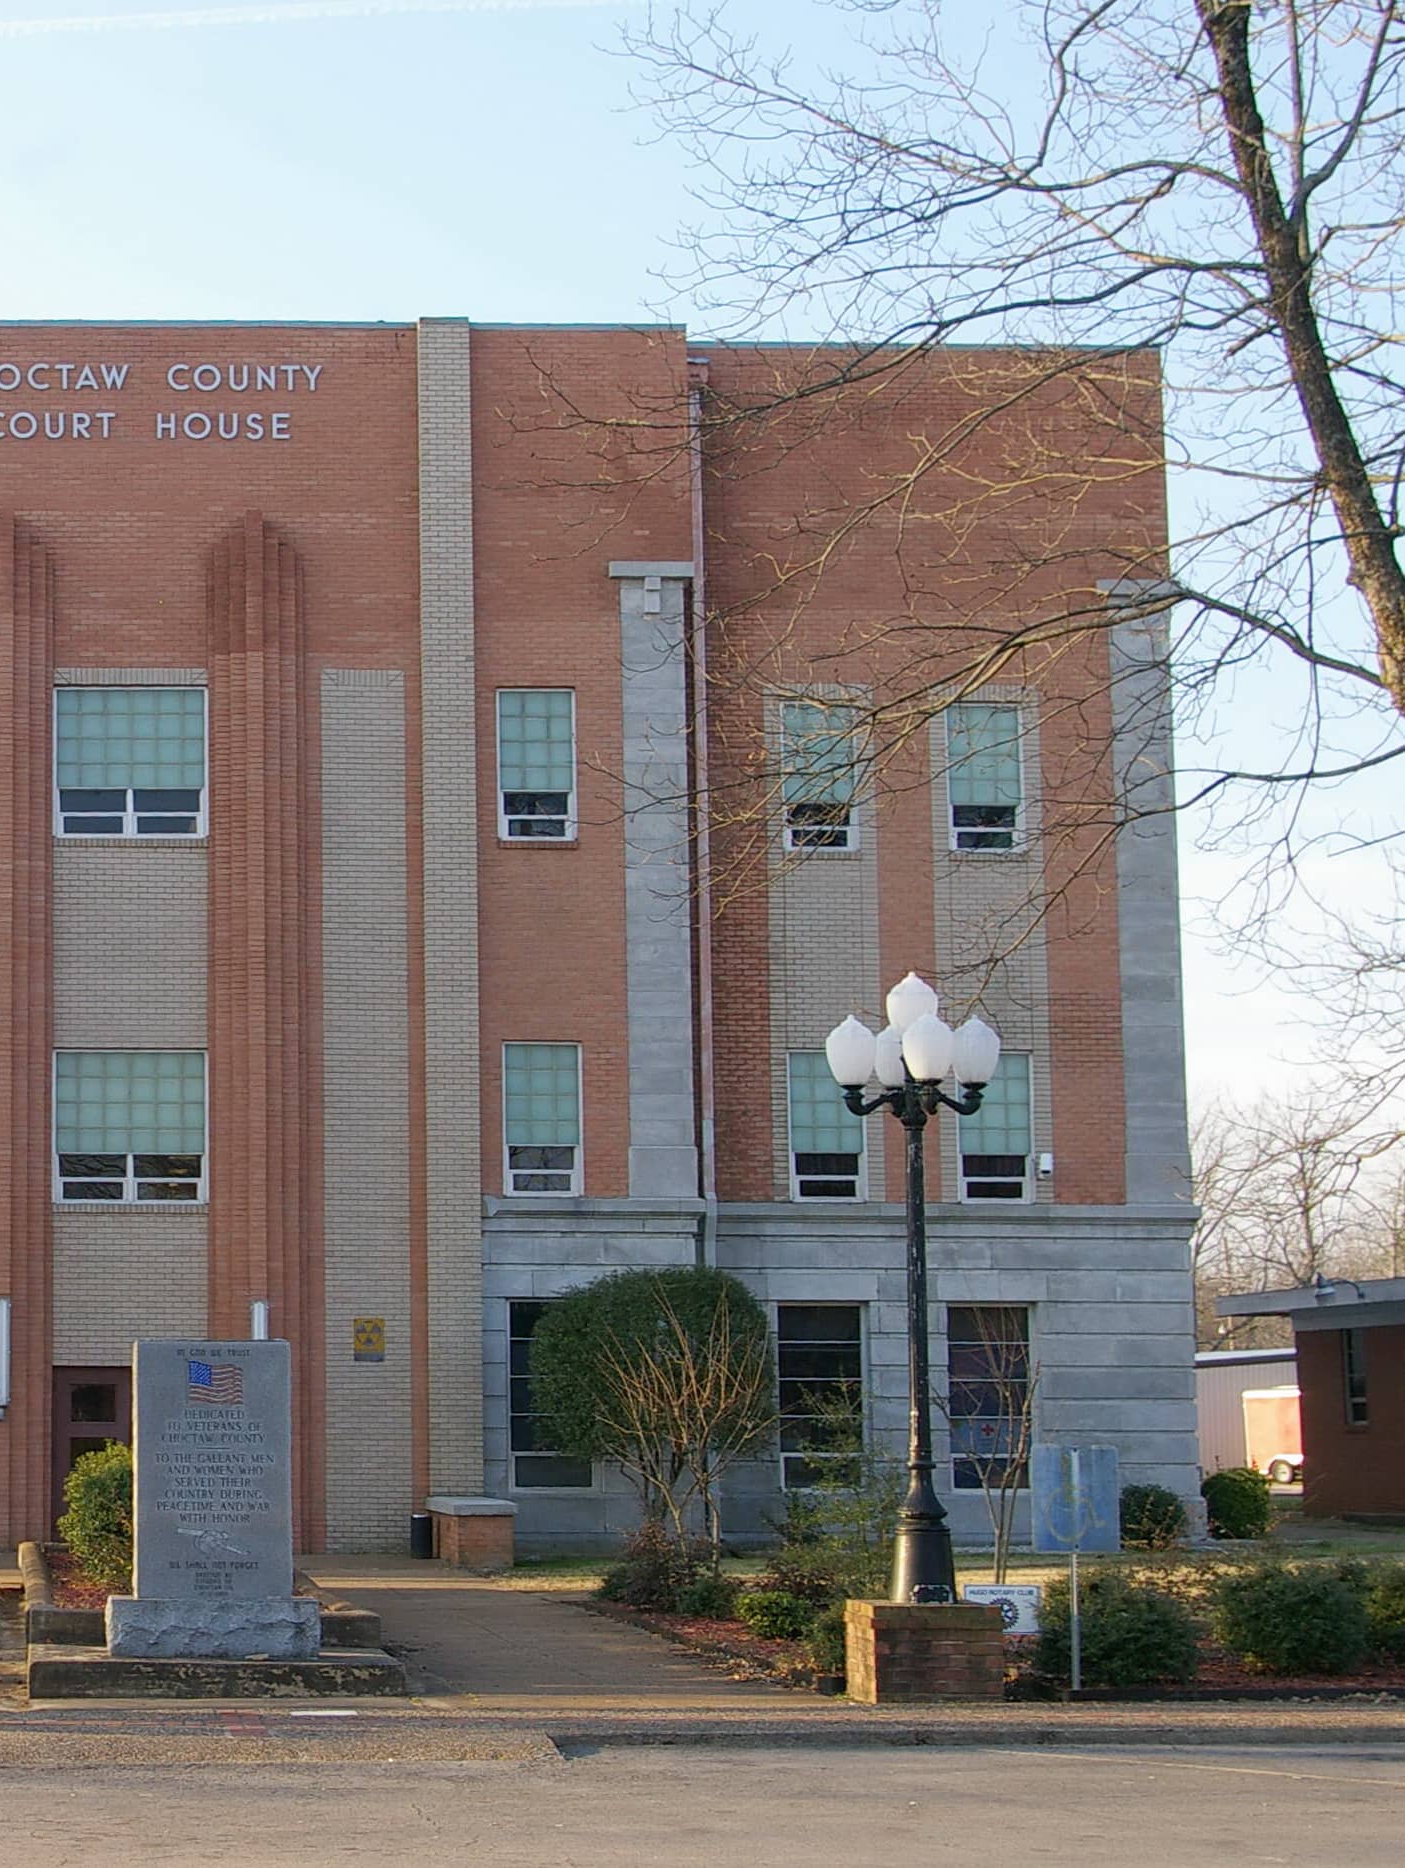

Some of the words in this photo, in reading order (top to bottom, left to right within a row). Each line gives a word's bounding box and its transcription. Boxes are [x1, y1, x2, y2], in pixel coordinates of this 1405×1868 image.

[166, 363, 323, 392] COUNTY
[156, 412, 292, 440] HOUSE
[190, 1349, 206, 1357] GOD
[227, 1349, 251, 1357] TRUST
[184, 1409, 245, 1420] DEDICATED
[168, 1421, 181, 1431] TO
[187, 1421, 242, 1432] VETERANS
[248, 1422, 262, 1432] OF
[161, 1433, 214, 1444] CHOCTAW
[221, 1433, 266, 1444] COUNTY
[155, 1452, 170, 1464] TO
[173, 1453, 193, 1464] THE
[197, 1453, 246, 1464] GALLANT
[251, 1453, 275, 1464] MEN
[168, 1465, 190, 1475] AND
[195, 1465, 234, 1476] WOMEN
[238, 1465, 264, 1475] WHO
[174, 1477, 215, 1488] SERVED
[219, 1477, 252, 1488] THEIR
[164, 1489, 214, 1500] COUNTRY
[220, 1489, 263, 1500] DURING
[156, 1501, 217, 1512] PEACETIME
[221, 1501, 243, 1512] AND
[247, 1501, 271, 1512] WAR
[179, 1513, 206, 1524] WITH
[212, 1513, 251, 1524] HONOR
[185, 1561, 207, 1569] SHALL
[230, 1561, 259, 1570] FORGET
